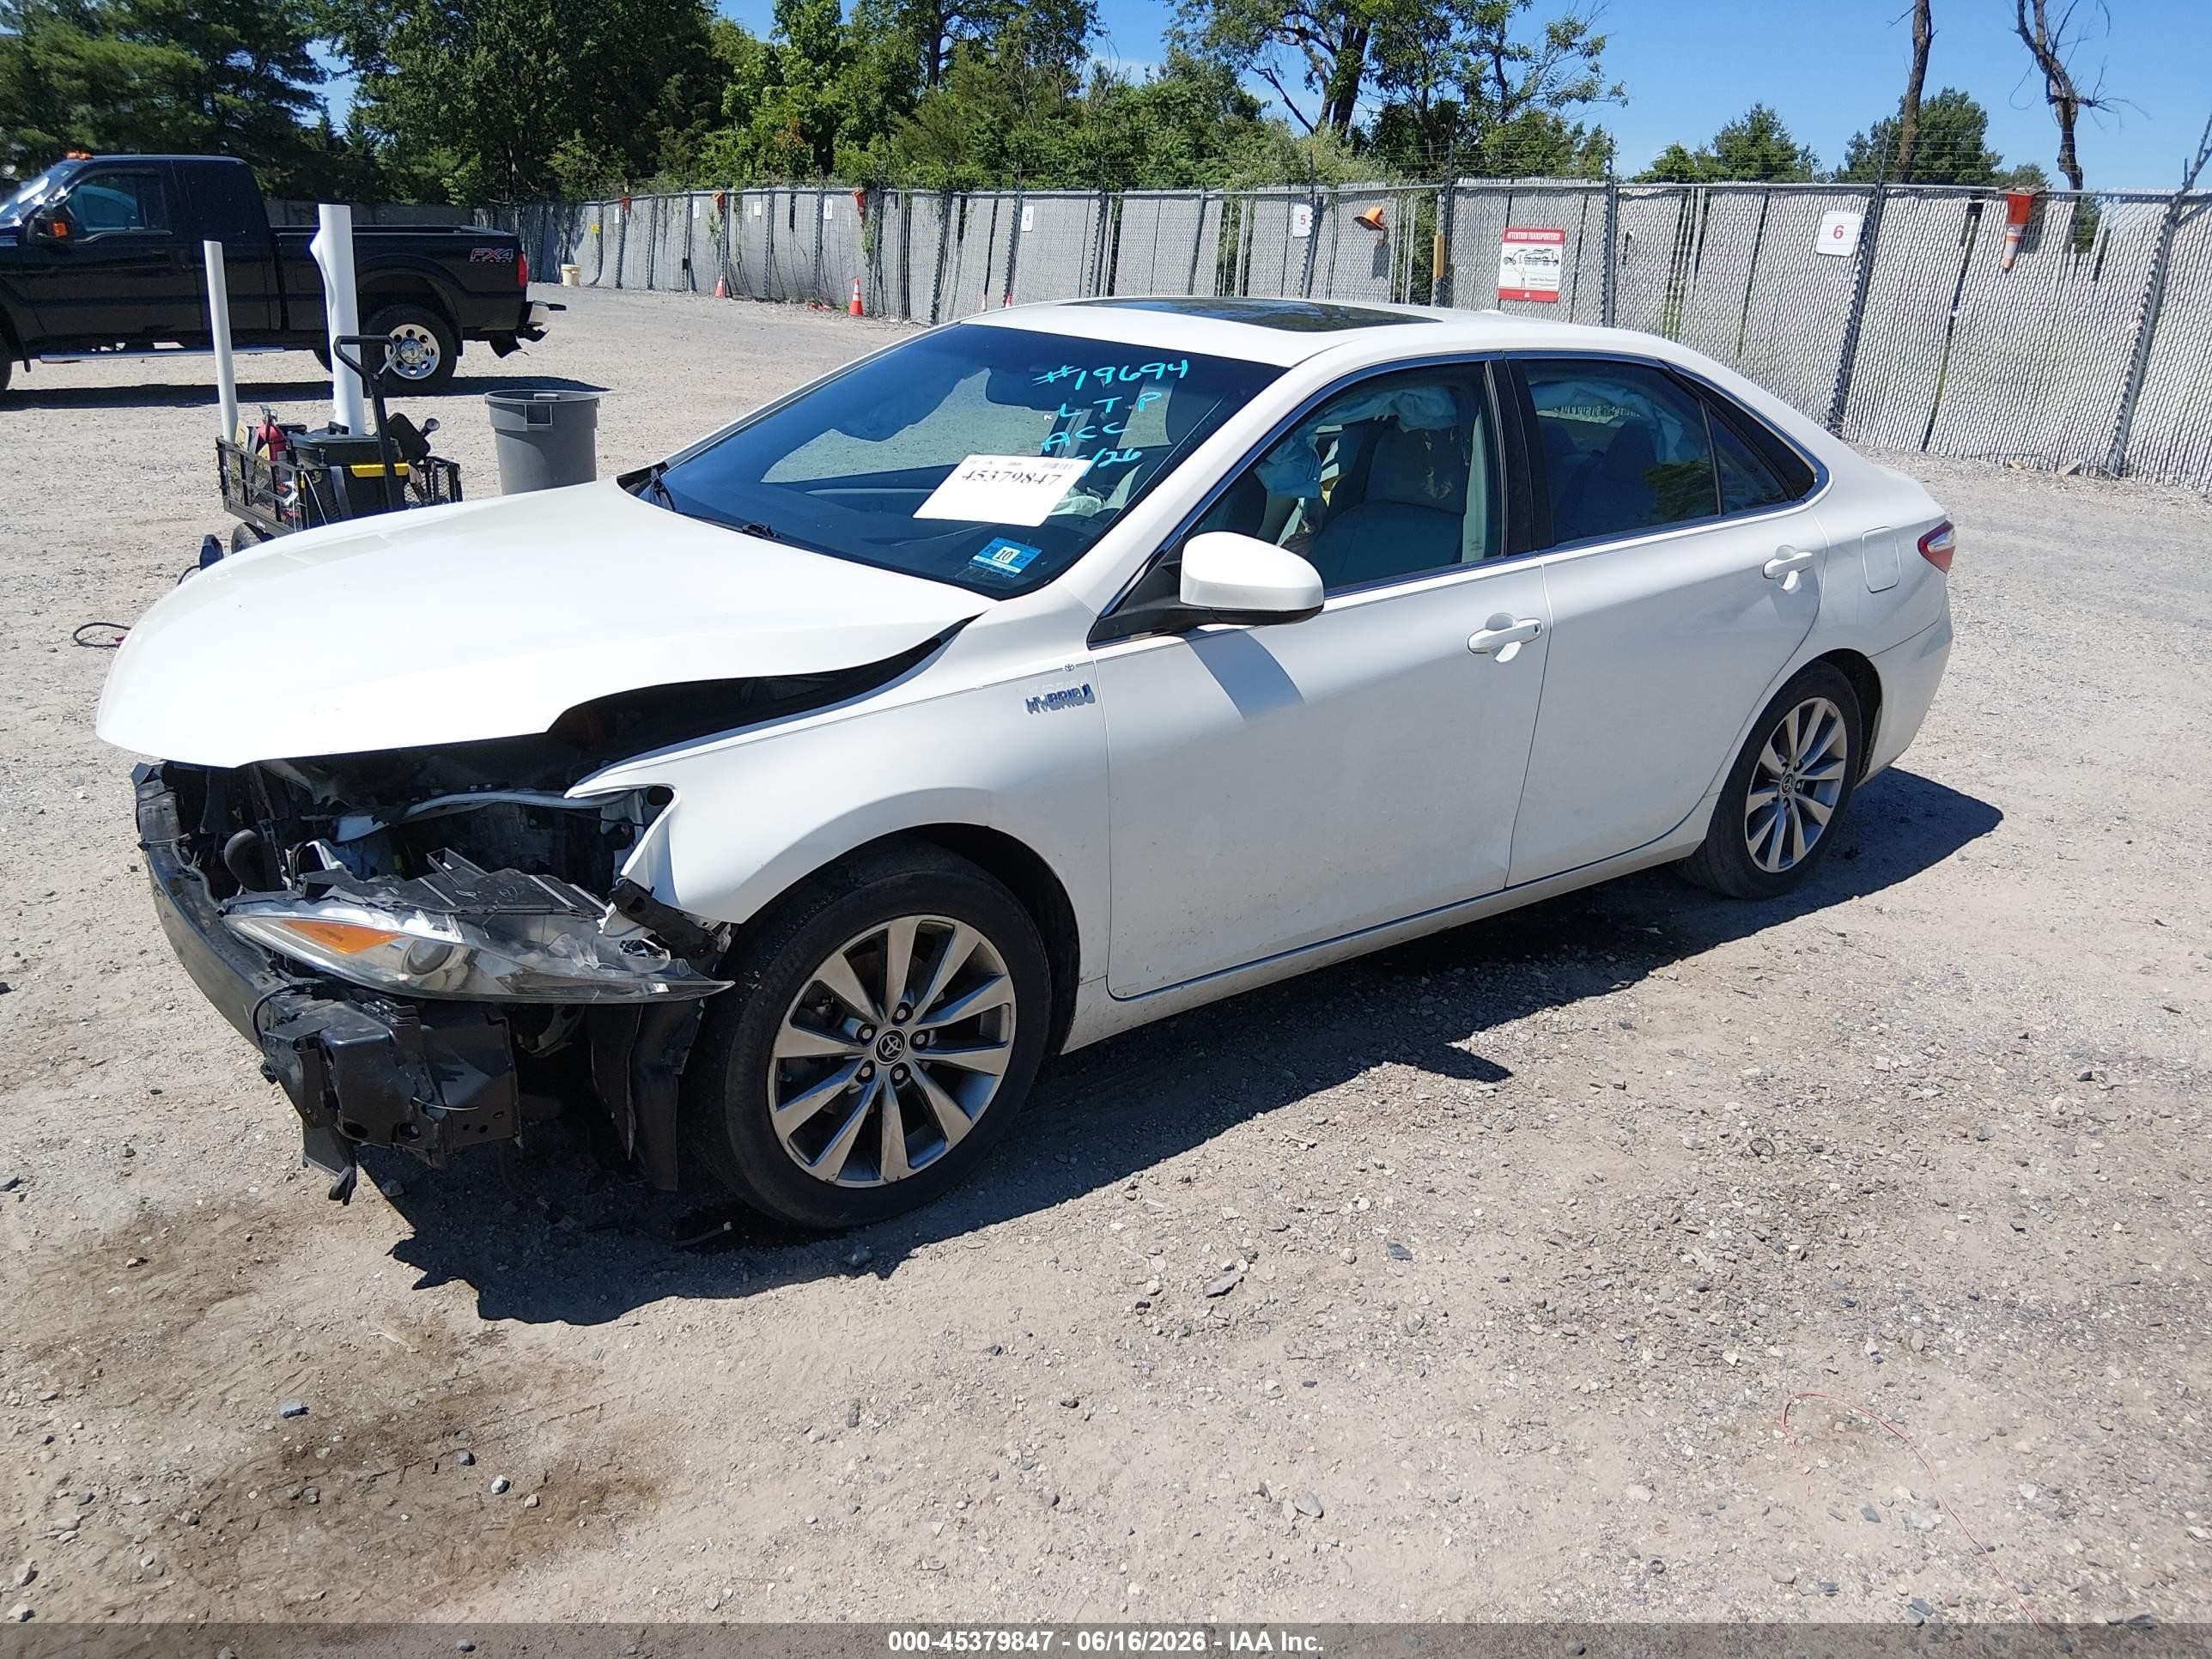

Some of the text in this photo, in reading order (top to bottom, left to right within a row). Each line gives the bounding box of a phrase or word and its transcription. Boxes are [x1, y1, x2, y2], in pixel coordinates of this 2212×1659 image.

[1300, 215, 1306, 225] 5
[1833, 225, 1844, 240] 6
[470, 248, 514, 260] FX4
[1031, 360, 1188, 390] #19694
[961, 470, 1062, 486] 45379847
[986, 545, 999, 555] 20
[994, 550, 1014, 562] 10
[1025, 687, 1085, 714] HYBRID
